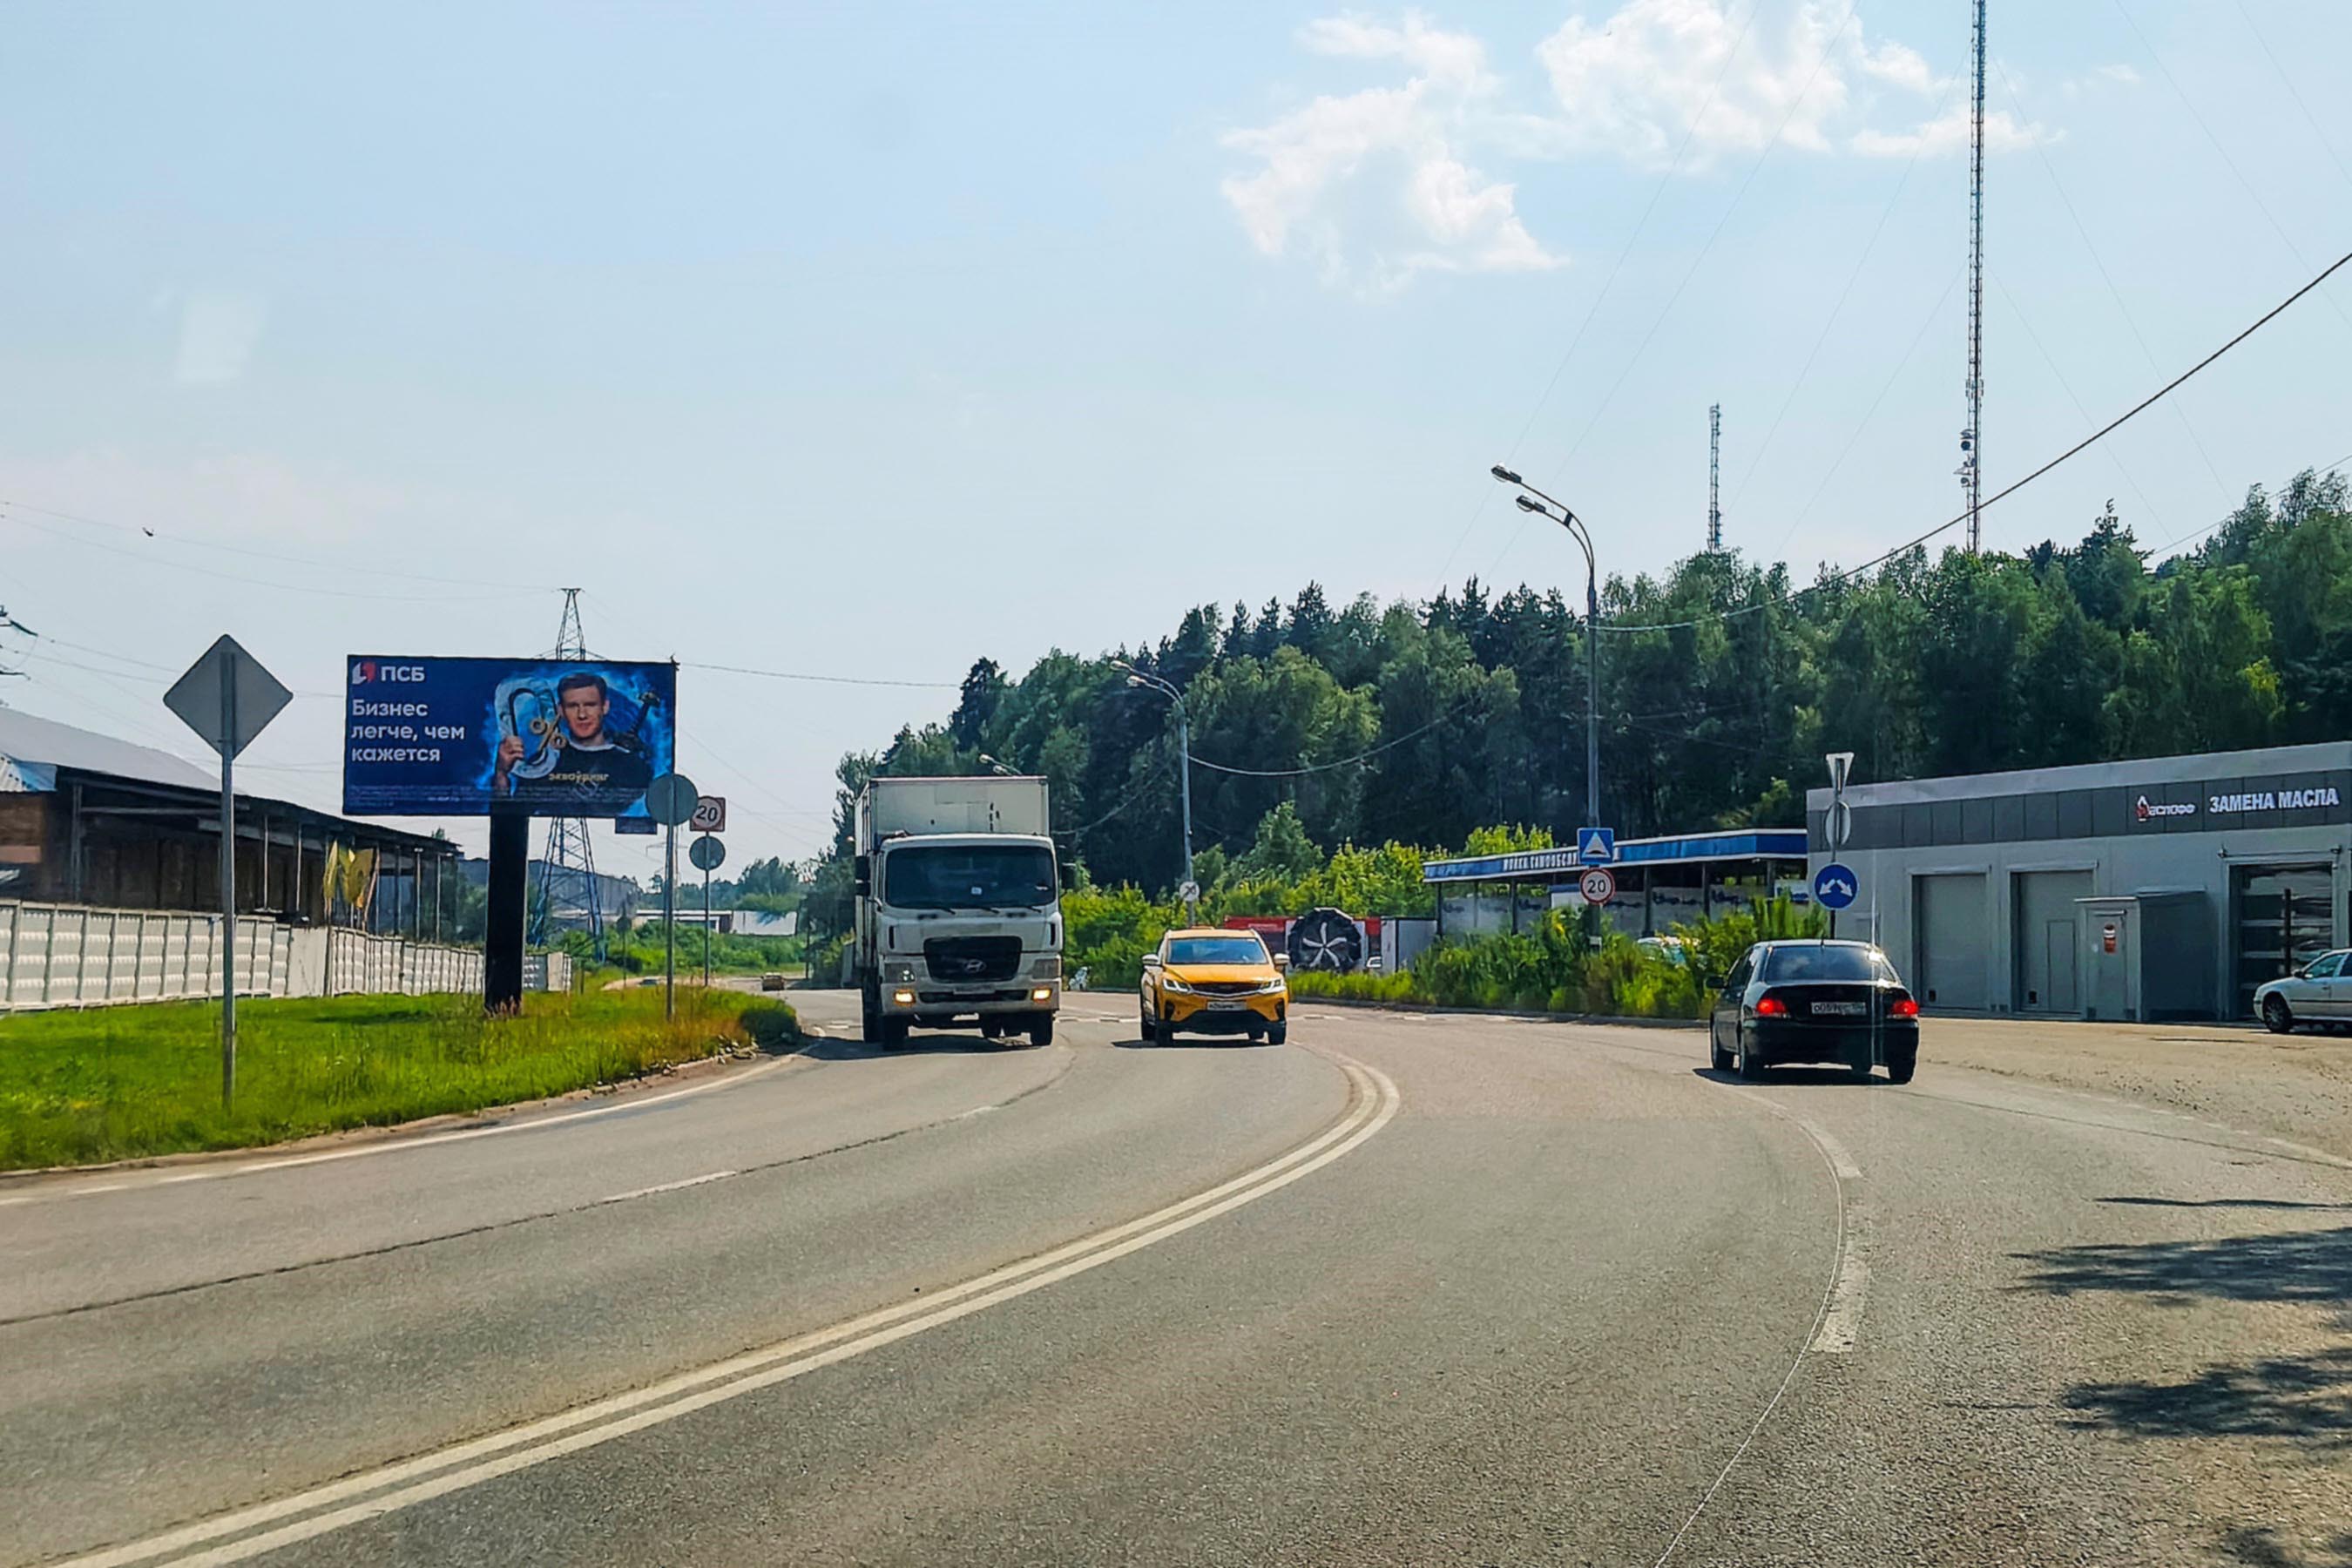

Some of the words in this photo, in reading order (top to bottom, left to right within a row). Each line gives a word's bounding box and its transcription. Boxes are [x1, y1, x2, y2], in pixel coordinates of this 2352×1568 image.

[381, 666, 425, 682] ПСБ
[352, 699, 429, 717] Бизнес
[351, 726, 418, 741] легче,
[424, 726, 465, 740] чем
[351, 747, 441, 762] кажется
[2209, 792, 2275, 814] ЗАМЕНА
[2278, 787, 2340, 810] МАСЛА
[696, 805, 719, 822] 20
[1587, 879, 1606, 894] 20
